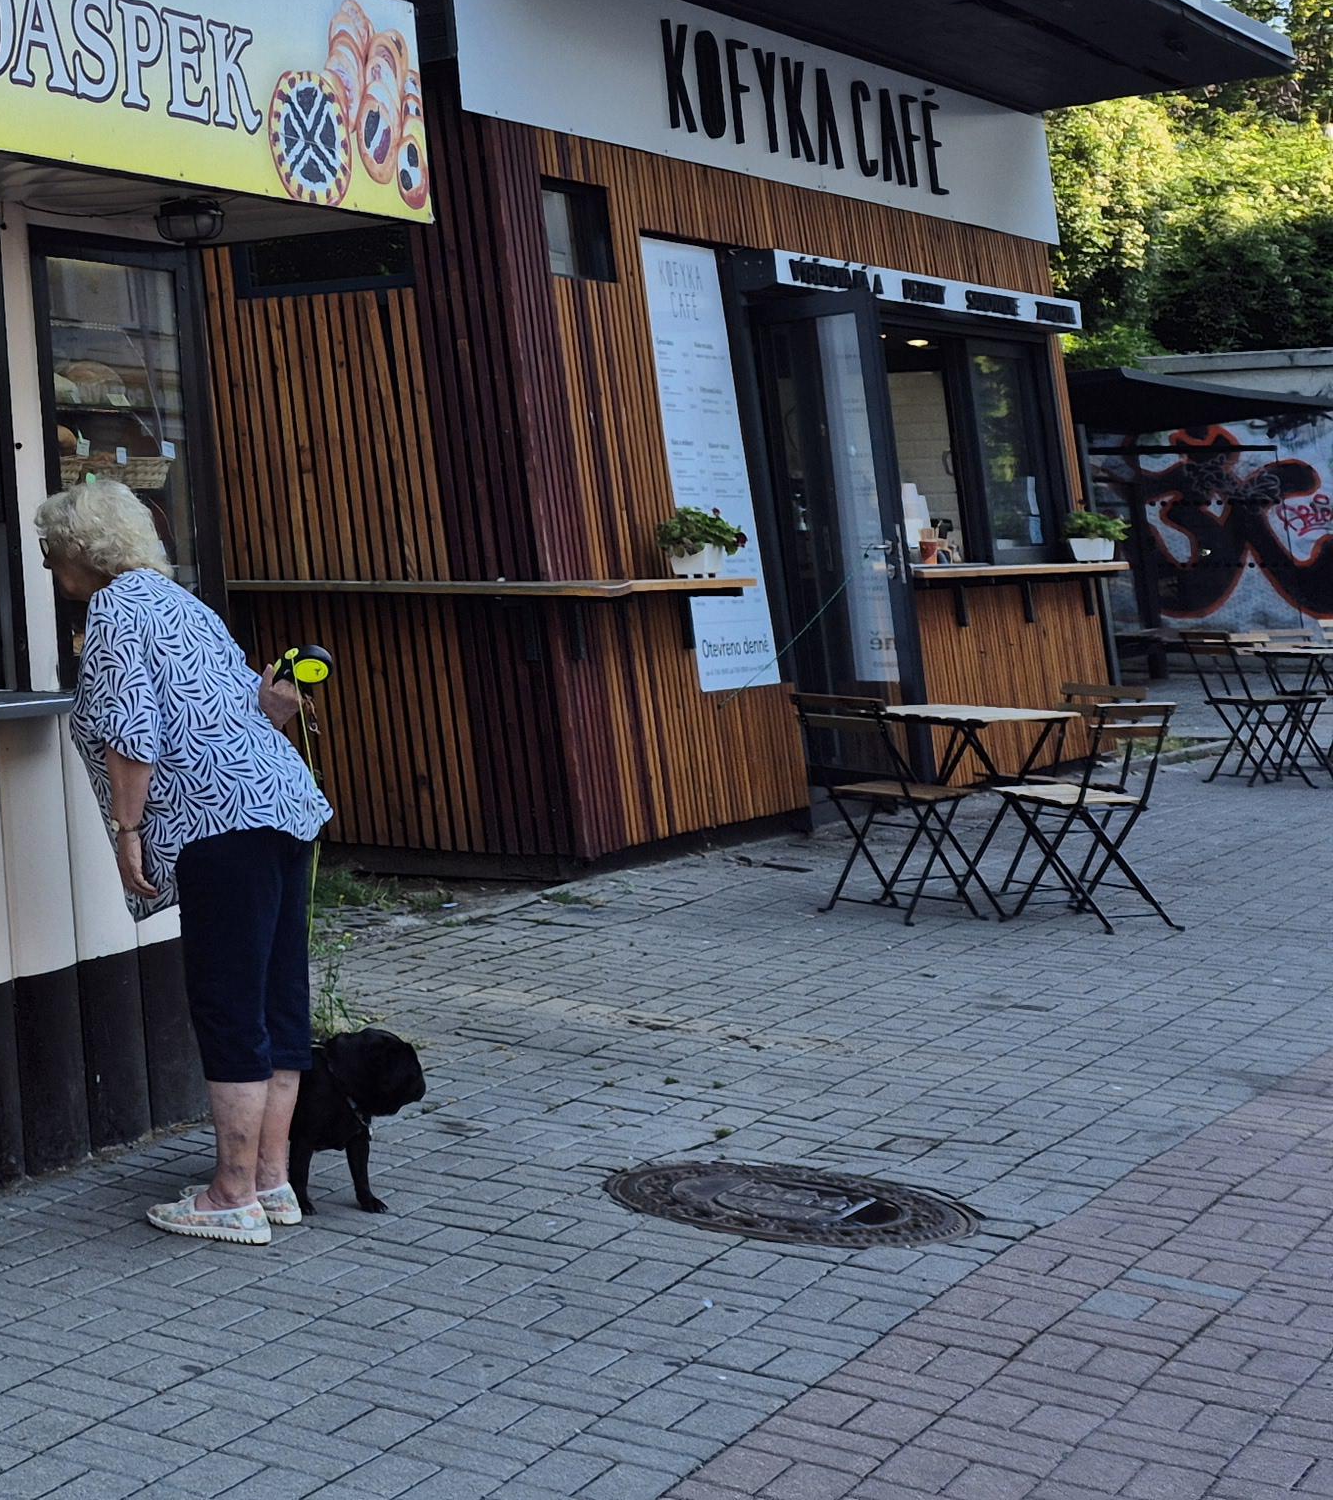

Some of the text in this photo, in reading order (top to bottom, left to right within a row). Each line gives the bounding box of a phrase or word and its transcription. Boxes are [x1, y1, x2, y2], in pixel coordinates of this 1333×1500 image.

[661, 19, 949, 195] KOFYKA CAFÉ
[658, 260, 703, 291] KOFYKA
[702, 634, 769, 658] Otevřeno denně
